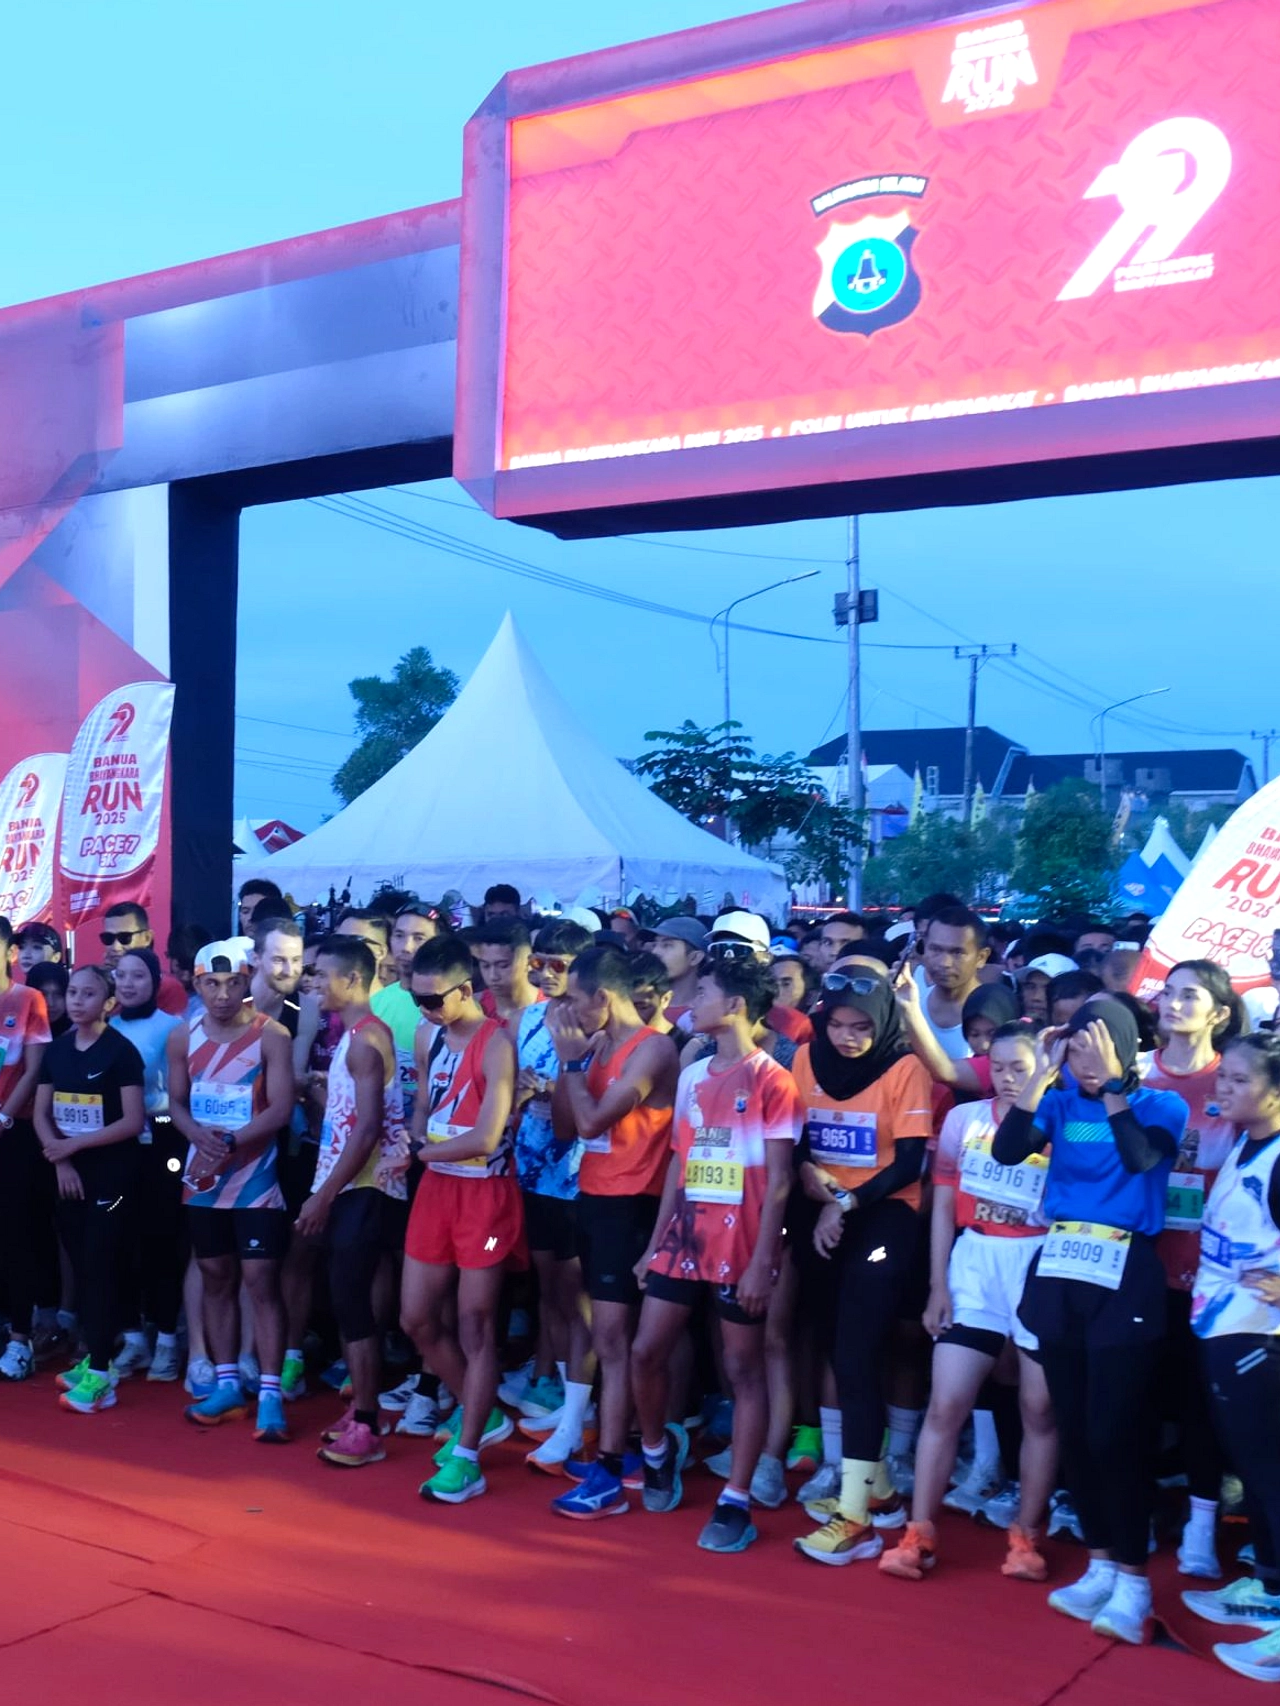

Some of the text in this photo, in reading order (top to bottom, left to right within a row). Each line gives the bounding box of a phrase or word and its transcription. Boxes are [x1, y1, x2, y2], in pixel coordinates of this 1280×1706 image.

[93, 753, 138, 768] BANUA
[80, 781, 144, 816] RUN
[94, 811, 126, 826] 2025
[1212, 857, 1280, 906] RU
[1224, 895, 1275, 919] 2025
[1181, 916, 1260, 954] PACE
[63, 1107, 90, 1125] 9915
[820, 1127, 857, 1150] 9651
[981, 1160, 1025, 1188] 9916
[1060, 1239, 1104, 1264] 9909
